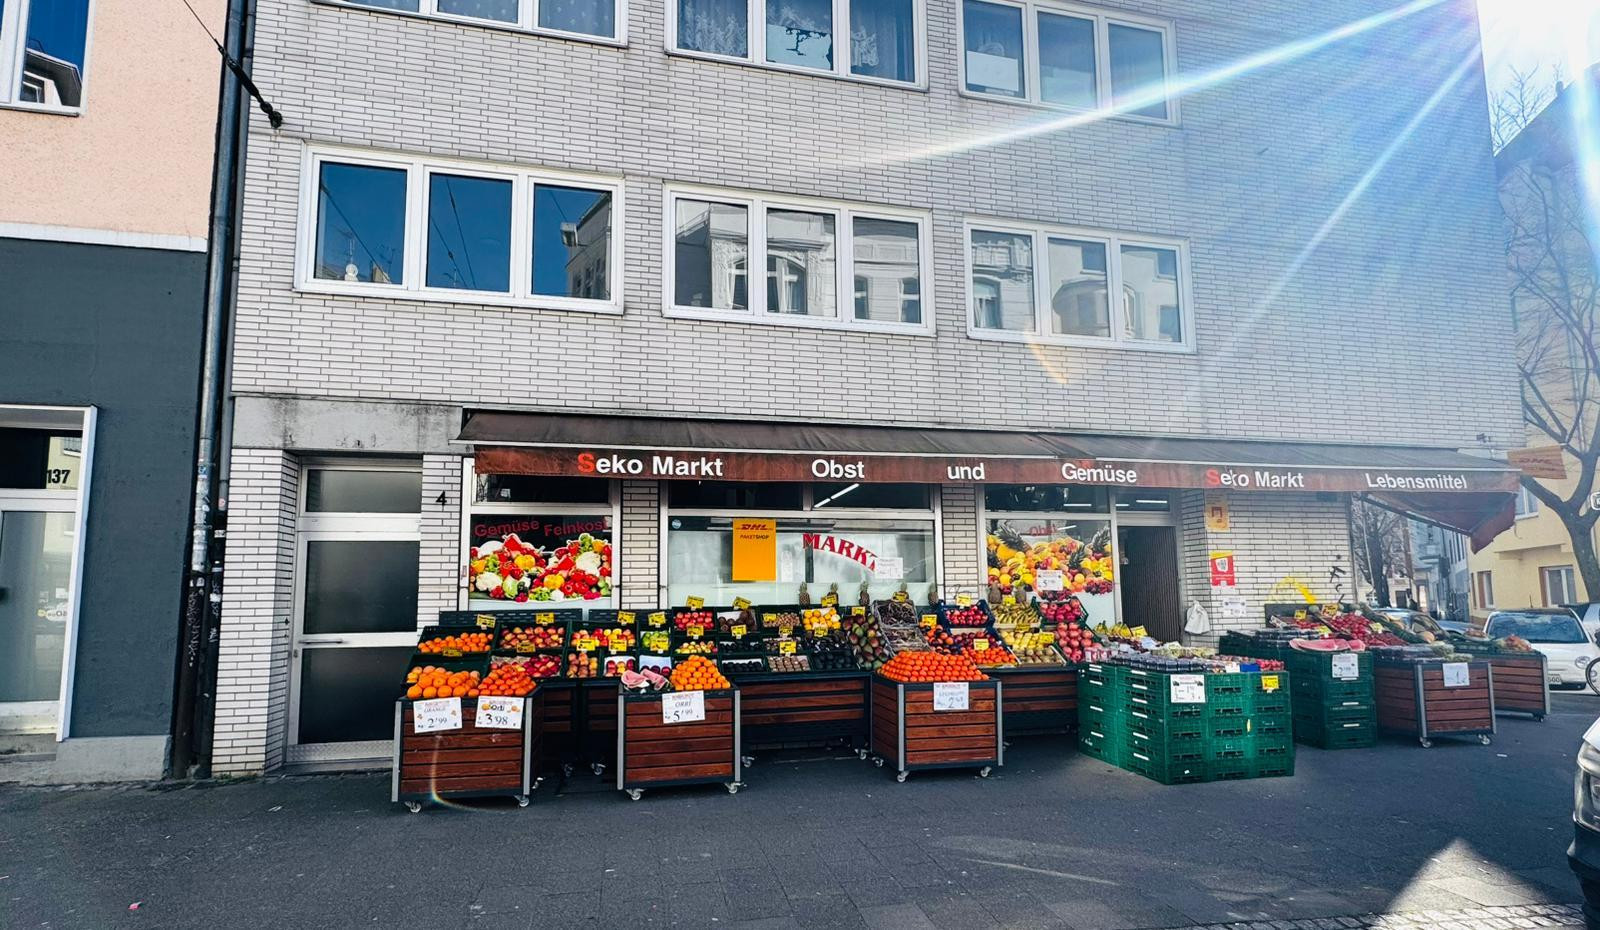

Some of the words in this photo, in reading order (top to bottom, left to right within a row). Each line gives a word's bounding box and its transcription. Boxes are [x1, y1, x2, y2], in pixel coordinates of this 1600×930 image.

[578, 453, 644, 474] Seko
[652, 456, 724, 477] Markt
[811, 458, 865, 479] Obst
[947, 463, 985, 480] und
[1061, 462, 1138, 484] Gemüse
[46, 469, 70, 484] 137
[1206, 468, 1249, 487] Seko
[1254, 470, 1304, 488] Markt
[1365, 473, 1467, 489] Lebensmittel
[435, 490, 447, 506] 4
[474, 519, 540, 537] Gemüse
[543, 517, 609, 537] Feinkost
[740, 523, 768, 531] DHL
